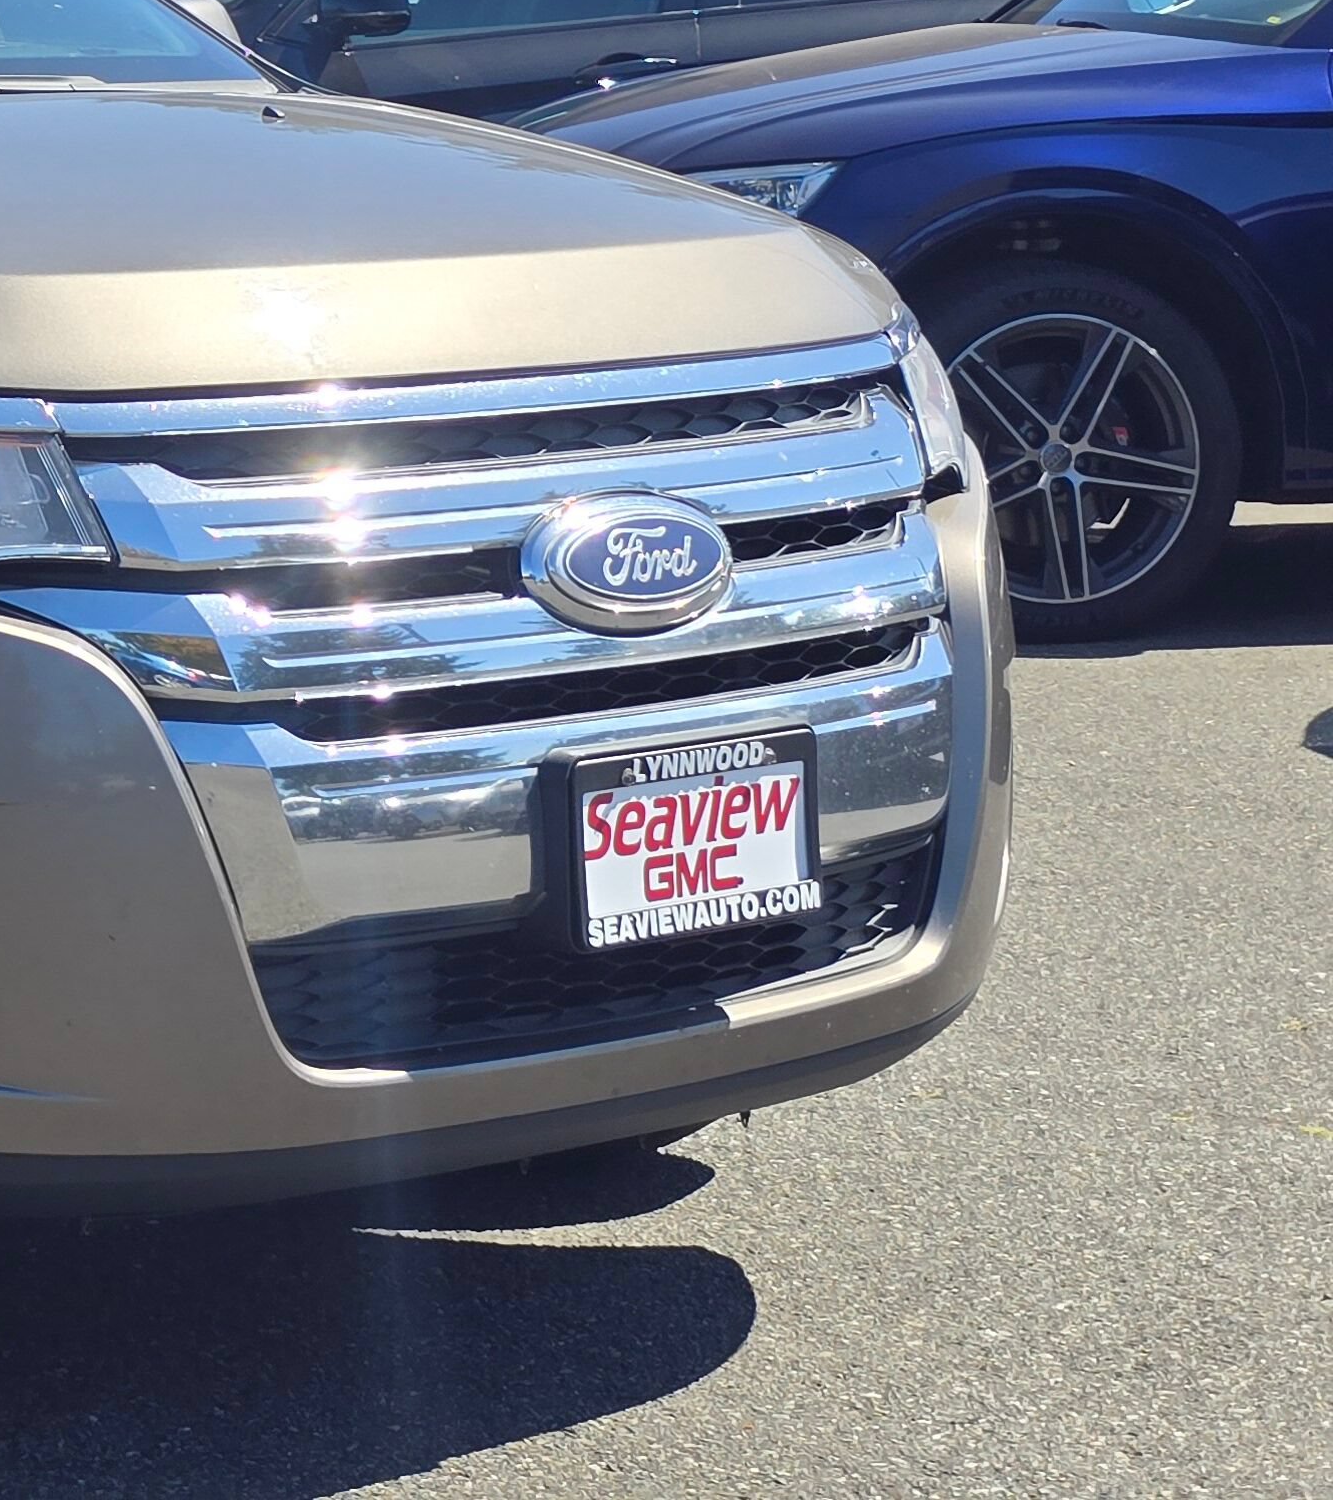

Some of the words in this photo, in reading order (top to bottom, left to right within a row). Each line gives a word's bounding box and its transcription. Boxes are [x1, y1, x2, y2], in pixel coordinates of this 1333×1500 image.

[602, 525, 698, 587] Ford
[633, 741, 765, 783] LYNNWOOD
[585, 776, 800, 861] Seaview
[644, 844, 744, 902] GMC
[588, 882, 821, 948] SEAVIEWAUTO.COM
